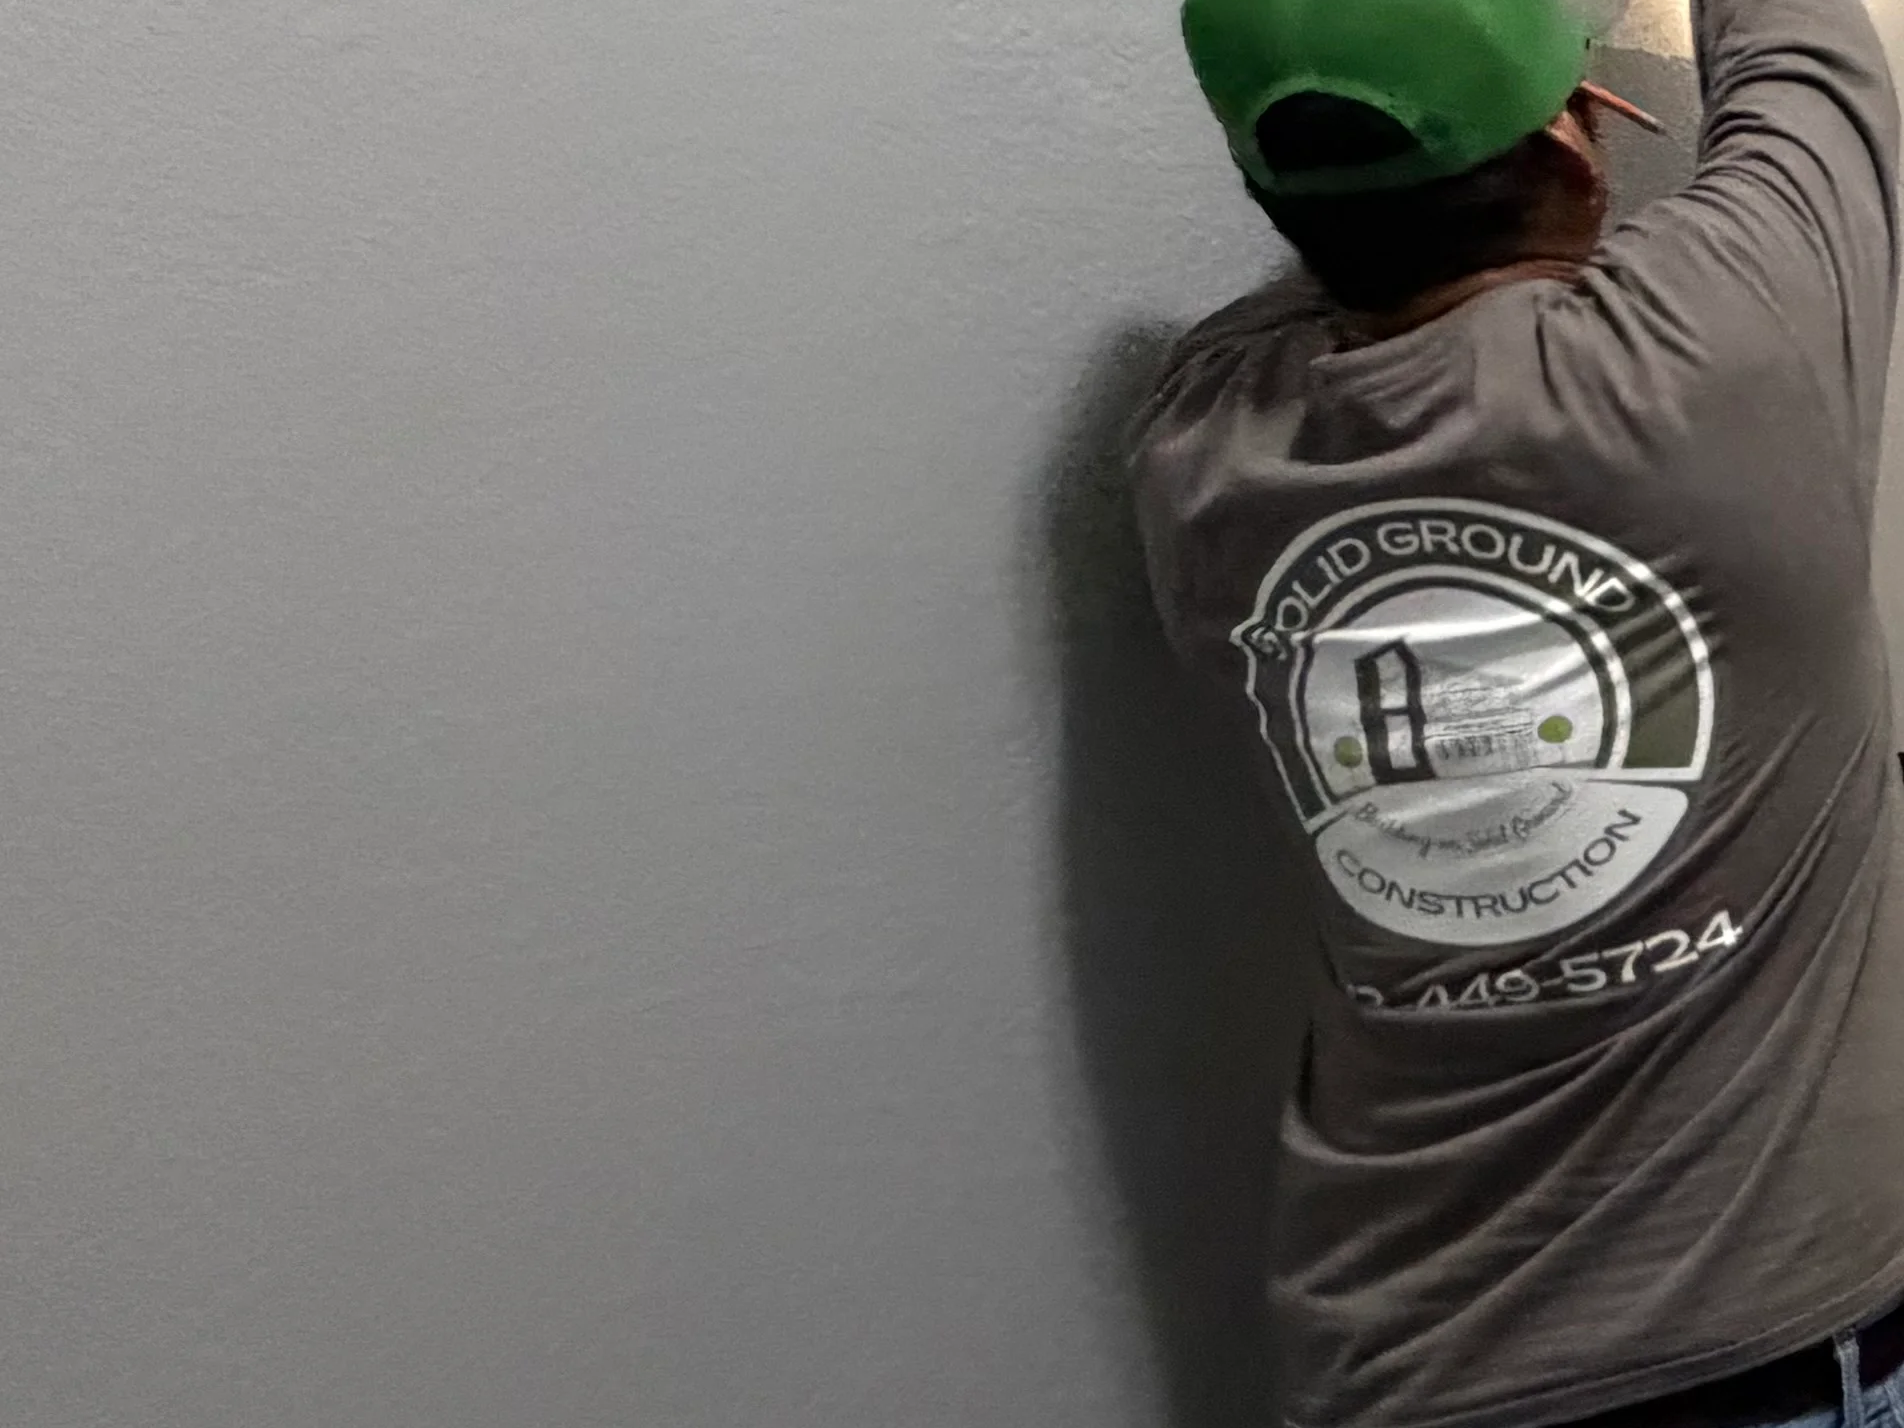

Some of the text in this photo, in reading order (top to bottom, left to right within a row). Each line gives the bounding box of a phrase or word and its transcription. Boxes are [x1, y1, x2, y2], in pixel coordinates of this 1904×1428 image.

[1250, 518, 1636, 660] SOLID GROUND
[1332, 806, 1643, 922] CONSTRUCTION
